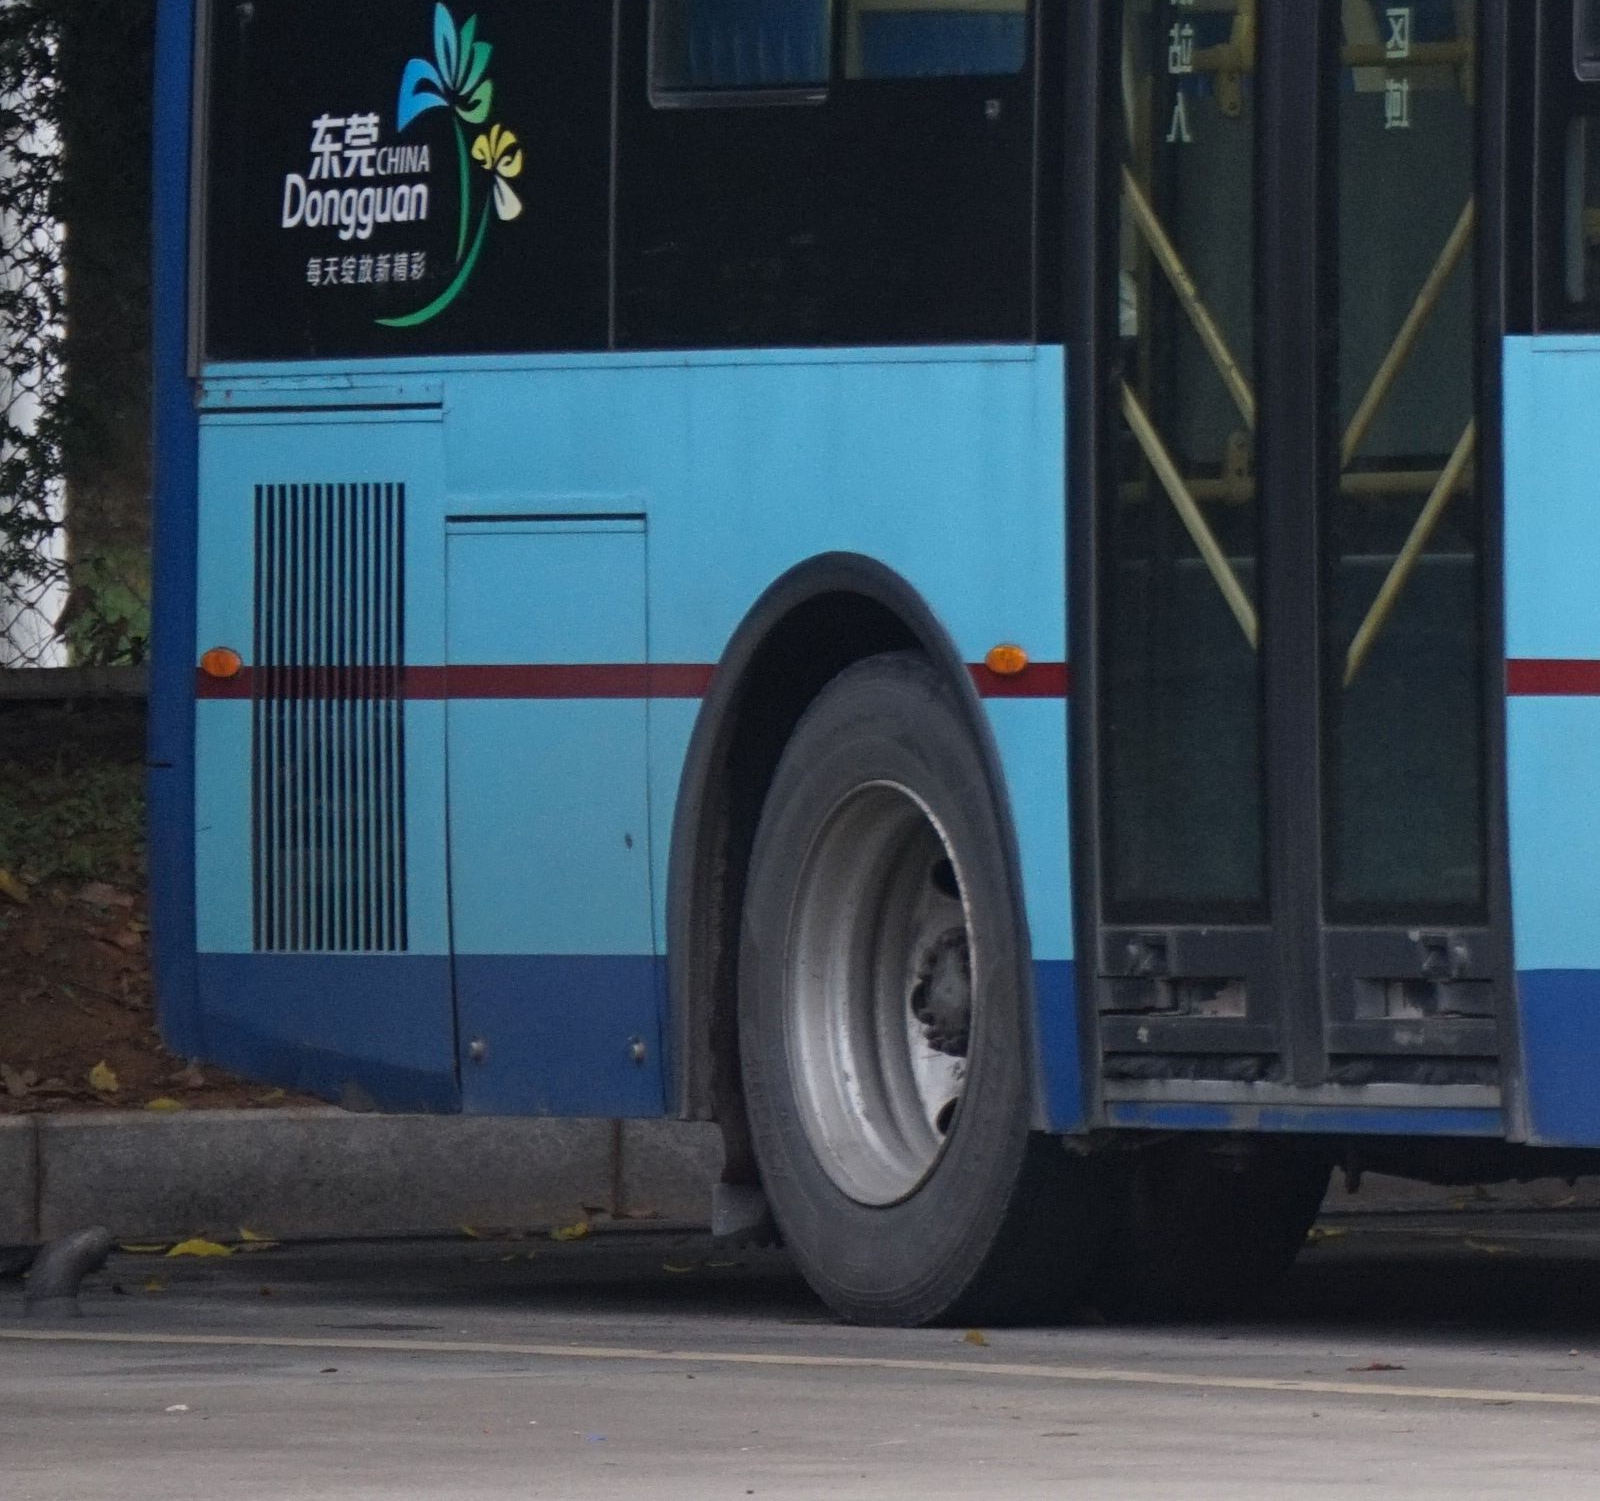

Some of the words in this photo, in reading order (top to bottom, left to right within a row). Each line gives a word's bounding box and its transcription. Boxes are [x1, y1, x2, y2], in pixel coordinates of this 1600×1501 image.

[308, 112, 381, 180] 东莞
[376, 144, 430, 176] CHINA
[281, 173, 428, 241] Dongguan
[306, 250, 427, 287] 每天绽放新精彩
